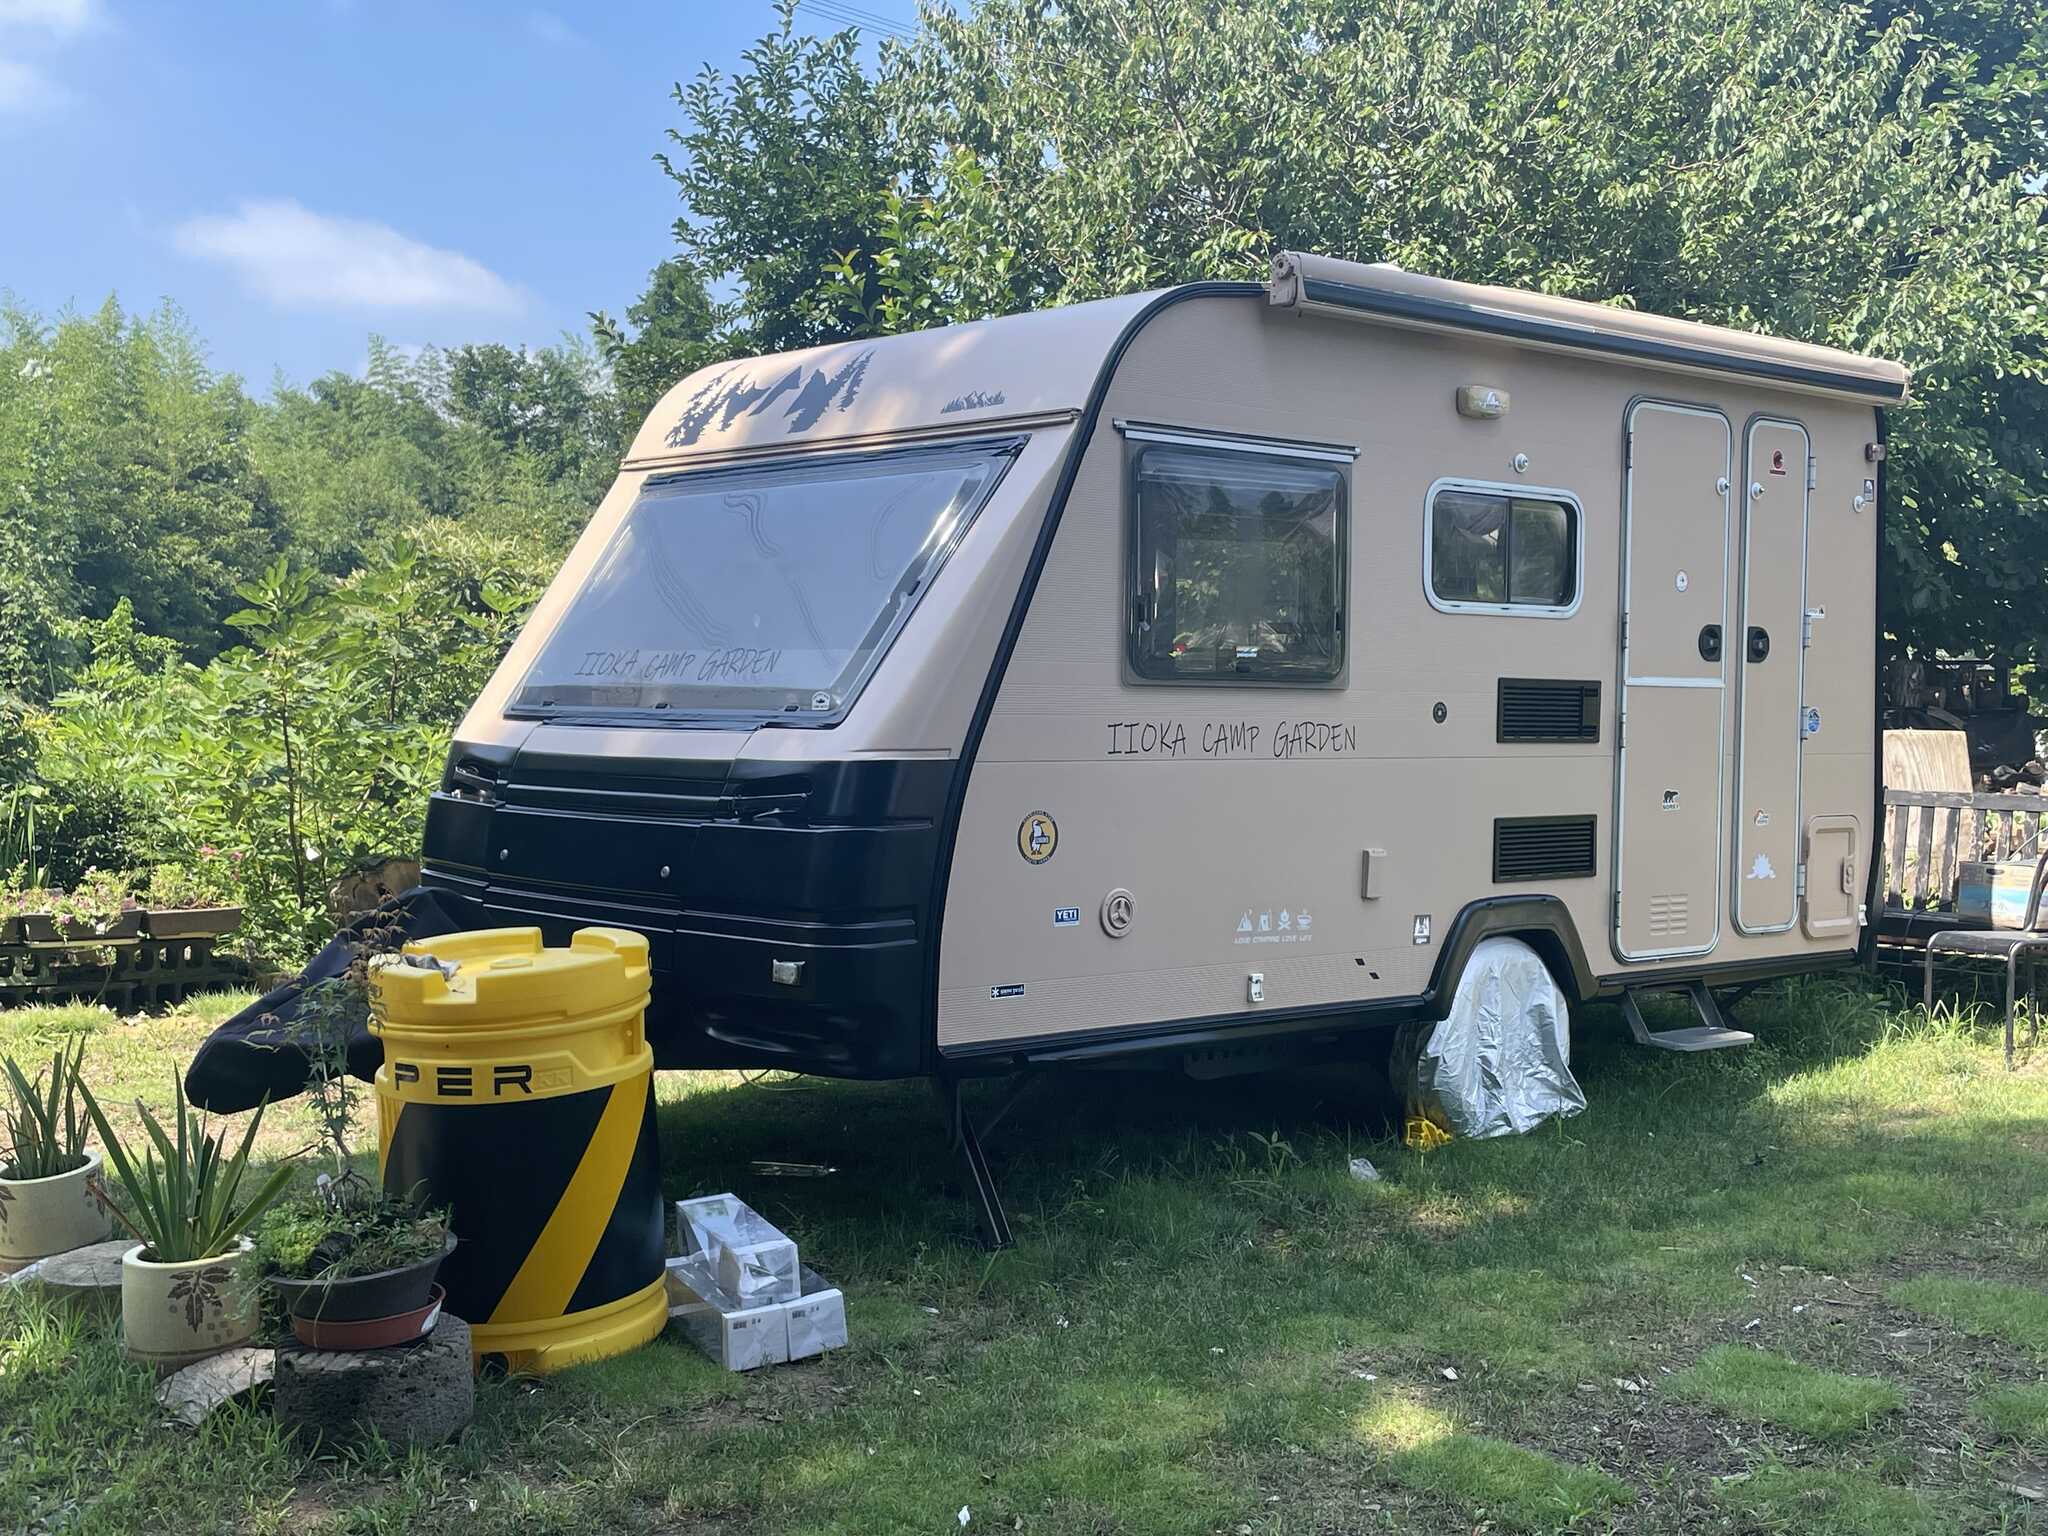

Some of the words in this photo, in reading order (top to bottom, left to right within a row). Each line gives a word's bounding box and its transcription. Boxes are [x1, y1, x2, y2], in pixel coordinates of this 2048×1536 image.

[574, 648, 639, 677] IIOKA
[643, 651, 696, 681] CAMP
[698, 647, 782, 681] GARDEN
[1107, 720, 1186, 757] IIOKA
[1202, 720, 1260, 757] CAMP
[1273, 720, 1356, 759] GARDEN
[1056, 909, 1077, 921] YETI
